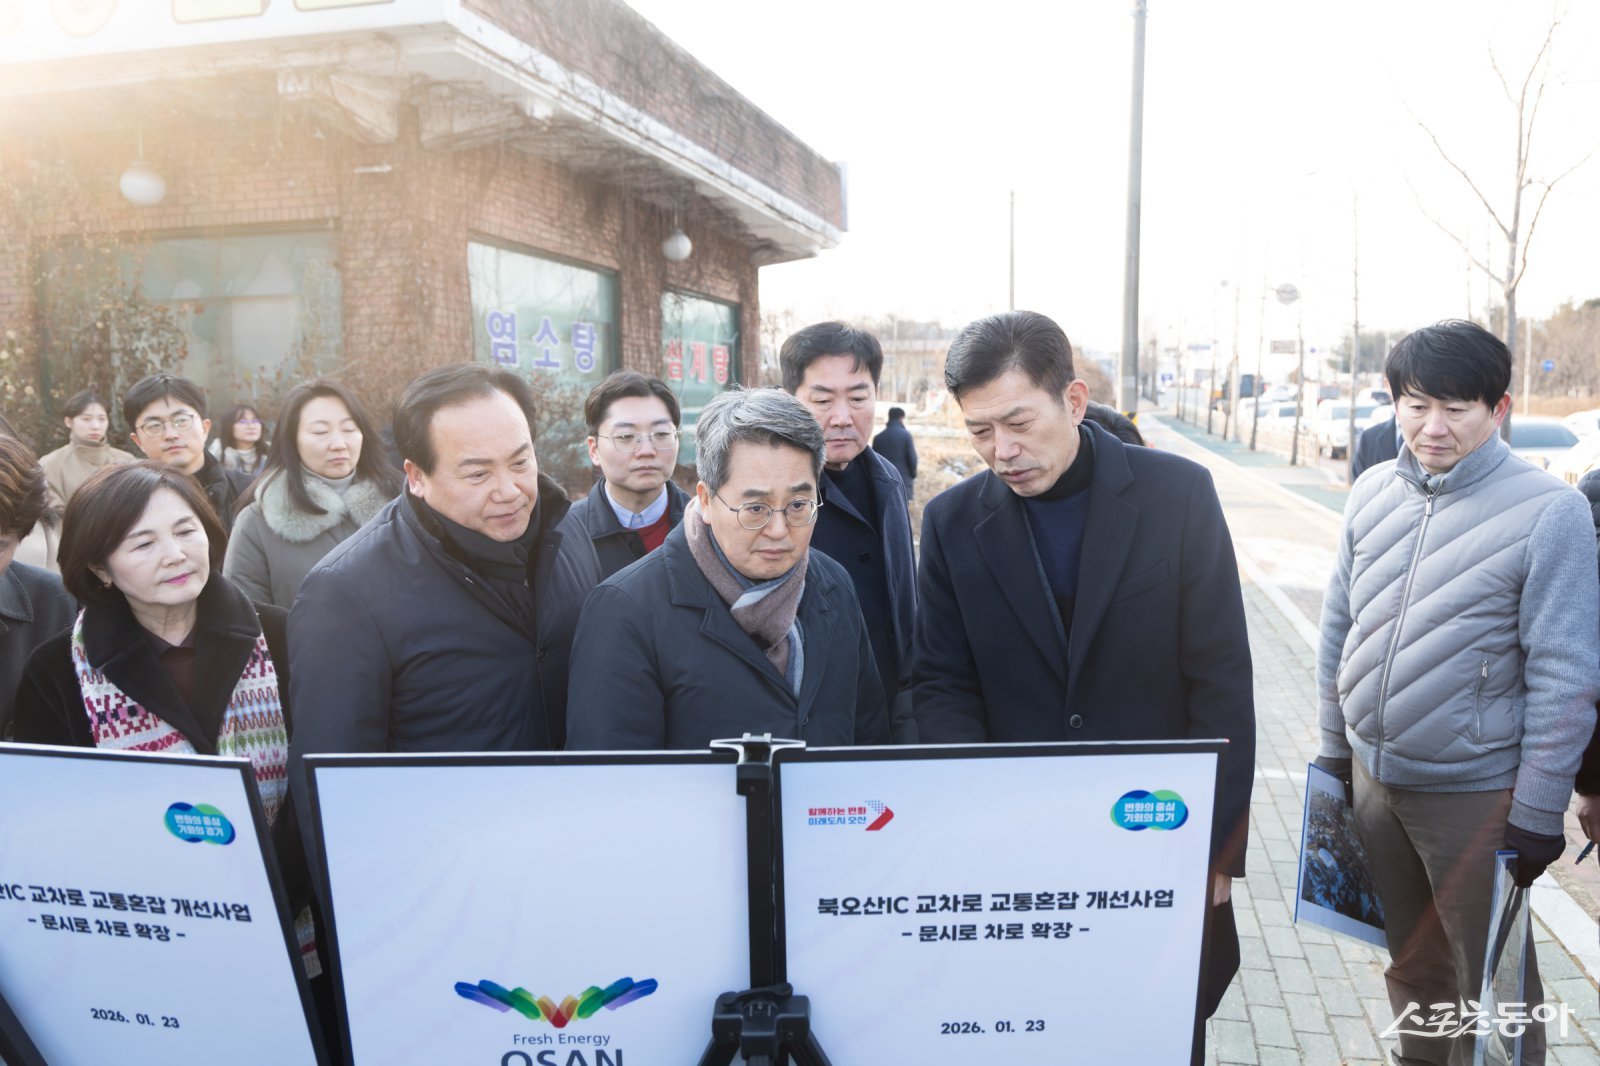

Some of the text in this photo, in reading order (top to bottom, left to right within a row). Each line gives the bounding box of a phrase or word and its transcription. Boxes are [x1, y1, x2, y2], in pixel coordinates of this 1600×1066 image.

[486, 309, 597, 373] 염소탕
[663, 337, 729, 385] 삼계탕
[808, 806, 867, 816] 함께하는 변화
[1124, 801, 1176, 812] 변화의 중심
[174, 814, 221, 827] 변화의 중심
[808, 816, 867, 826] 미래도시 오산
[1123, 812, 1175, 823] 기회의 경기
[177, 824, 224, 837] 기회의 경기
[28, 885, 87, 907] 교차로
[89, 890, 167, 915] 교통혼잡
[171, 897, 253, 923] 개선사업
[817, 889, 1174, 917] 북오산IC 교차로 교통혼잡 개선사업
[41, 914, 92, 934] 문시로
[94, 918, 132, 938] 차로
[133, 922, 171, 942] 확장
[918, 924, 978, 943] 문시로
[984, 923, 1024, 941] 차로
[1031, 921, 1073, 939] 확장
[90, 1007, 180, 1029] 2026. 01. 23
[940, 1019, 1045, 1035] 2026. 01. 23
[513, 1033, 610, 1047] Fresh Energy
[500, 1048, 623, 1066] OSAN
